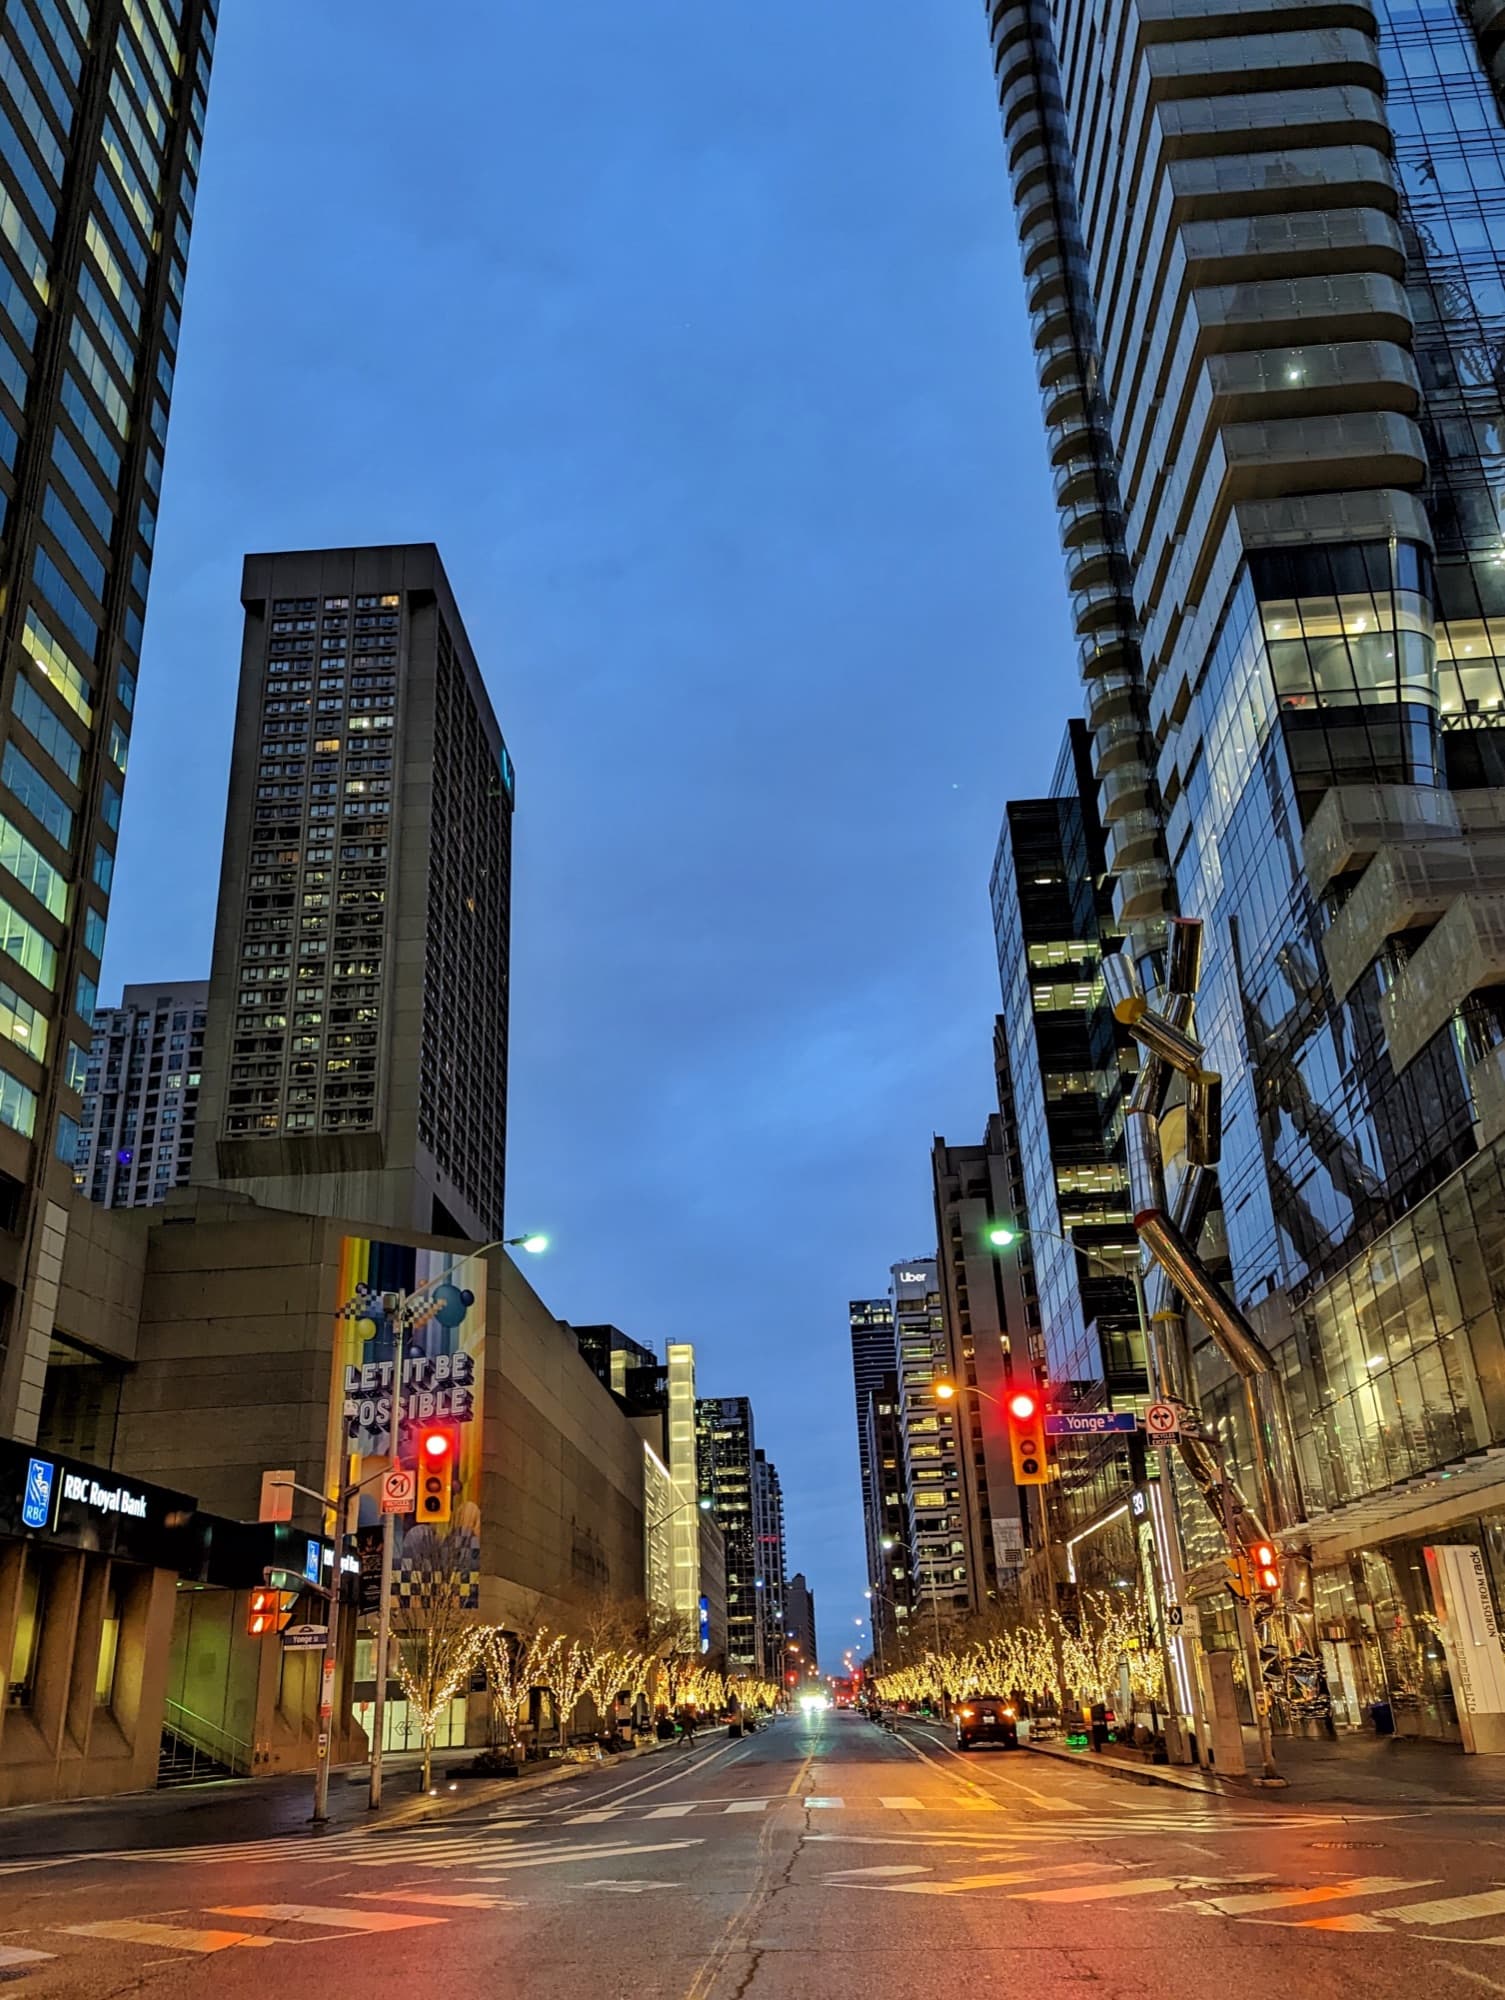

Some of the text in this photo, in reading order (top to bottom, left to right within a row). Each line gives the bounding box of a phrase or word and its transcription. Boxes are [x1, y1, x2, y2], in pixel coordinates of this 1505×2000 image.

[899, 1271, 927, 1282] Uber
[344, 1351, 468, 1391] LET IT BE
[1066, 1417, 1105, 1432] Yonge
[63, 1474, 148, 1518] RBC Royal Bank
[1133, 1492, 1144, 1515] 33
[25, 1505, 45, 1522] RBC
[1469, 1550, 1496, 1638] NORDSTROM rack
